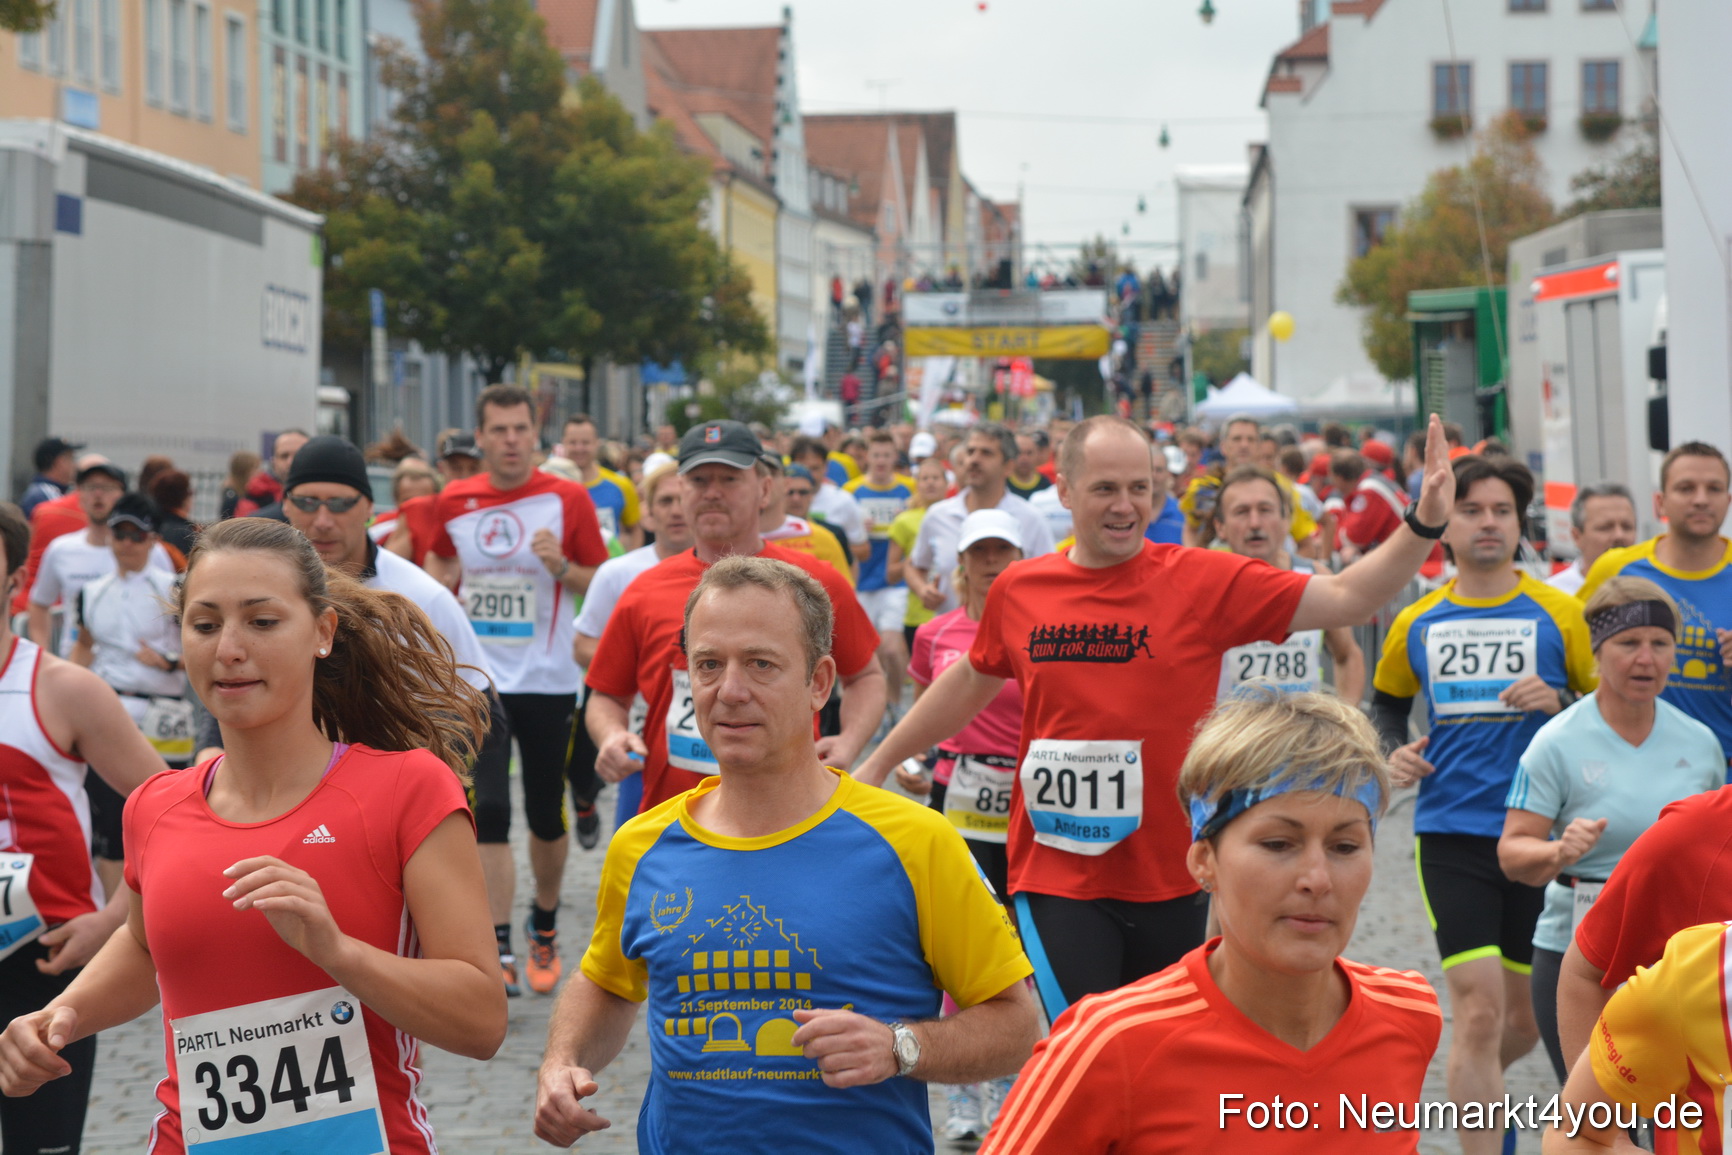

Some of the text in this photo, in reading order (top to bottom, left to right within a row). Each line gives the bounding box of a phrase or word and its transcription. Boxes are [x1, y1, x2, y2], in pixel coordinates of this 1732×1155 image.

[972, 331, 1040, 349] START
[471, 593, 526, 618] 2901
[1032, 641, 1129, 657] RUN FOR BÜRNI
[1439, 641, 1525, 676] 2575
[1239, 651, 1306, 680] 2788
[1063, 752, 1120, 763] Neumarkt
[1033, 767, 1125, 810] 2011
[1055, 818, 1110, 839] Andreas
[303, 836, 336, 844] adidas
[665, 893, 676, 902] 15
[657, 905, 682, 917] Jahre
[680, 998, 813, 1013] 21.September 2014
[177, 1011, 324, 1054] PARTL Neumarkt
[195, 1035, 356, 1131] 3344
